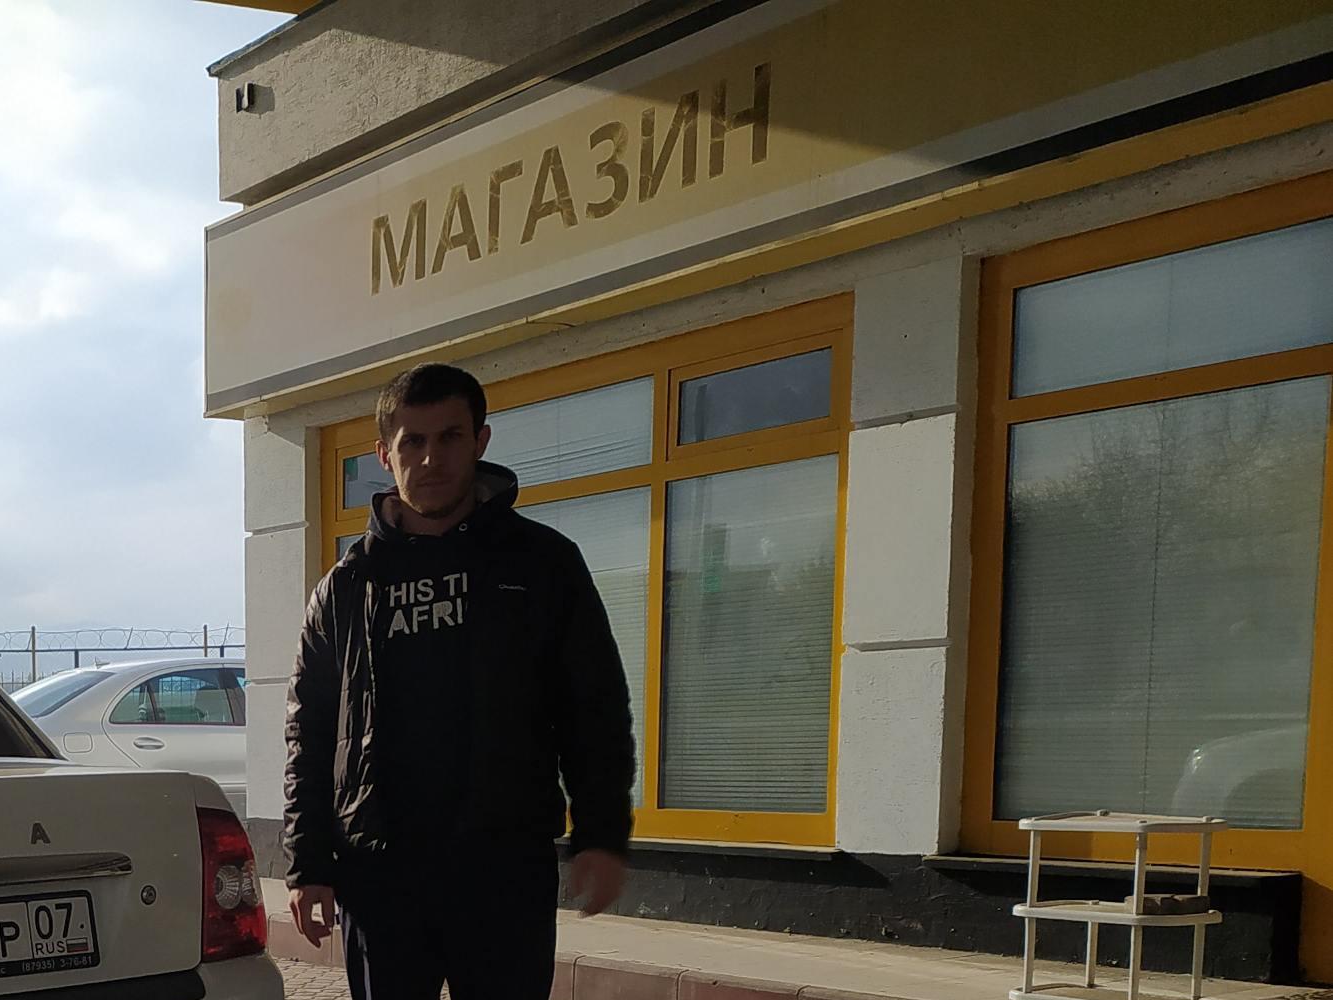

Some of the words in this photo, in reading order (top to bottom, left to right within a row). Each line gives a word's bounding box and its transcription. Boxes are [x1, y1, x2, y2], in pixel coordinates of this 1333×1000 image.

[371, 63, 771, 296] МАГАЗИН
[385, 578, 435, 607] HIS
[387, 598, 467, 639] AFRI
[33, 903, 73, 940] 07
[34, 940, 66, 956] RUS
